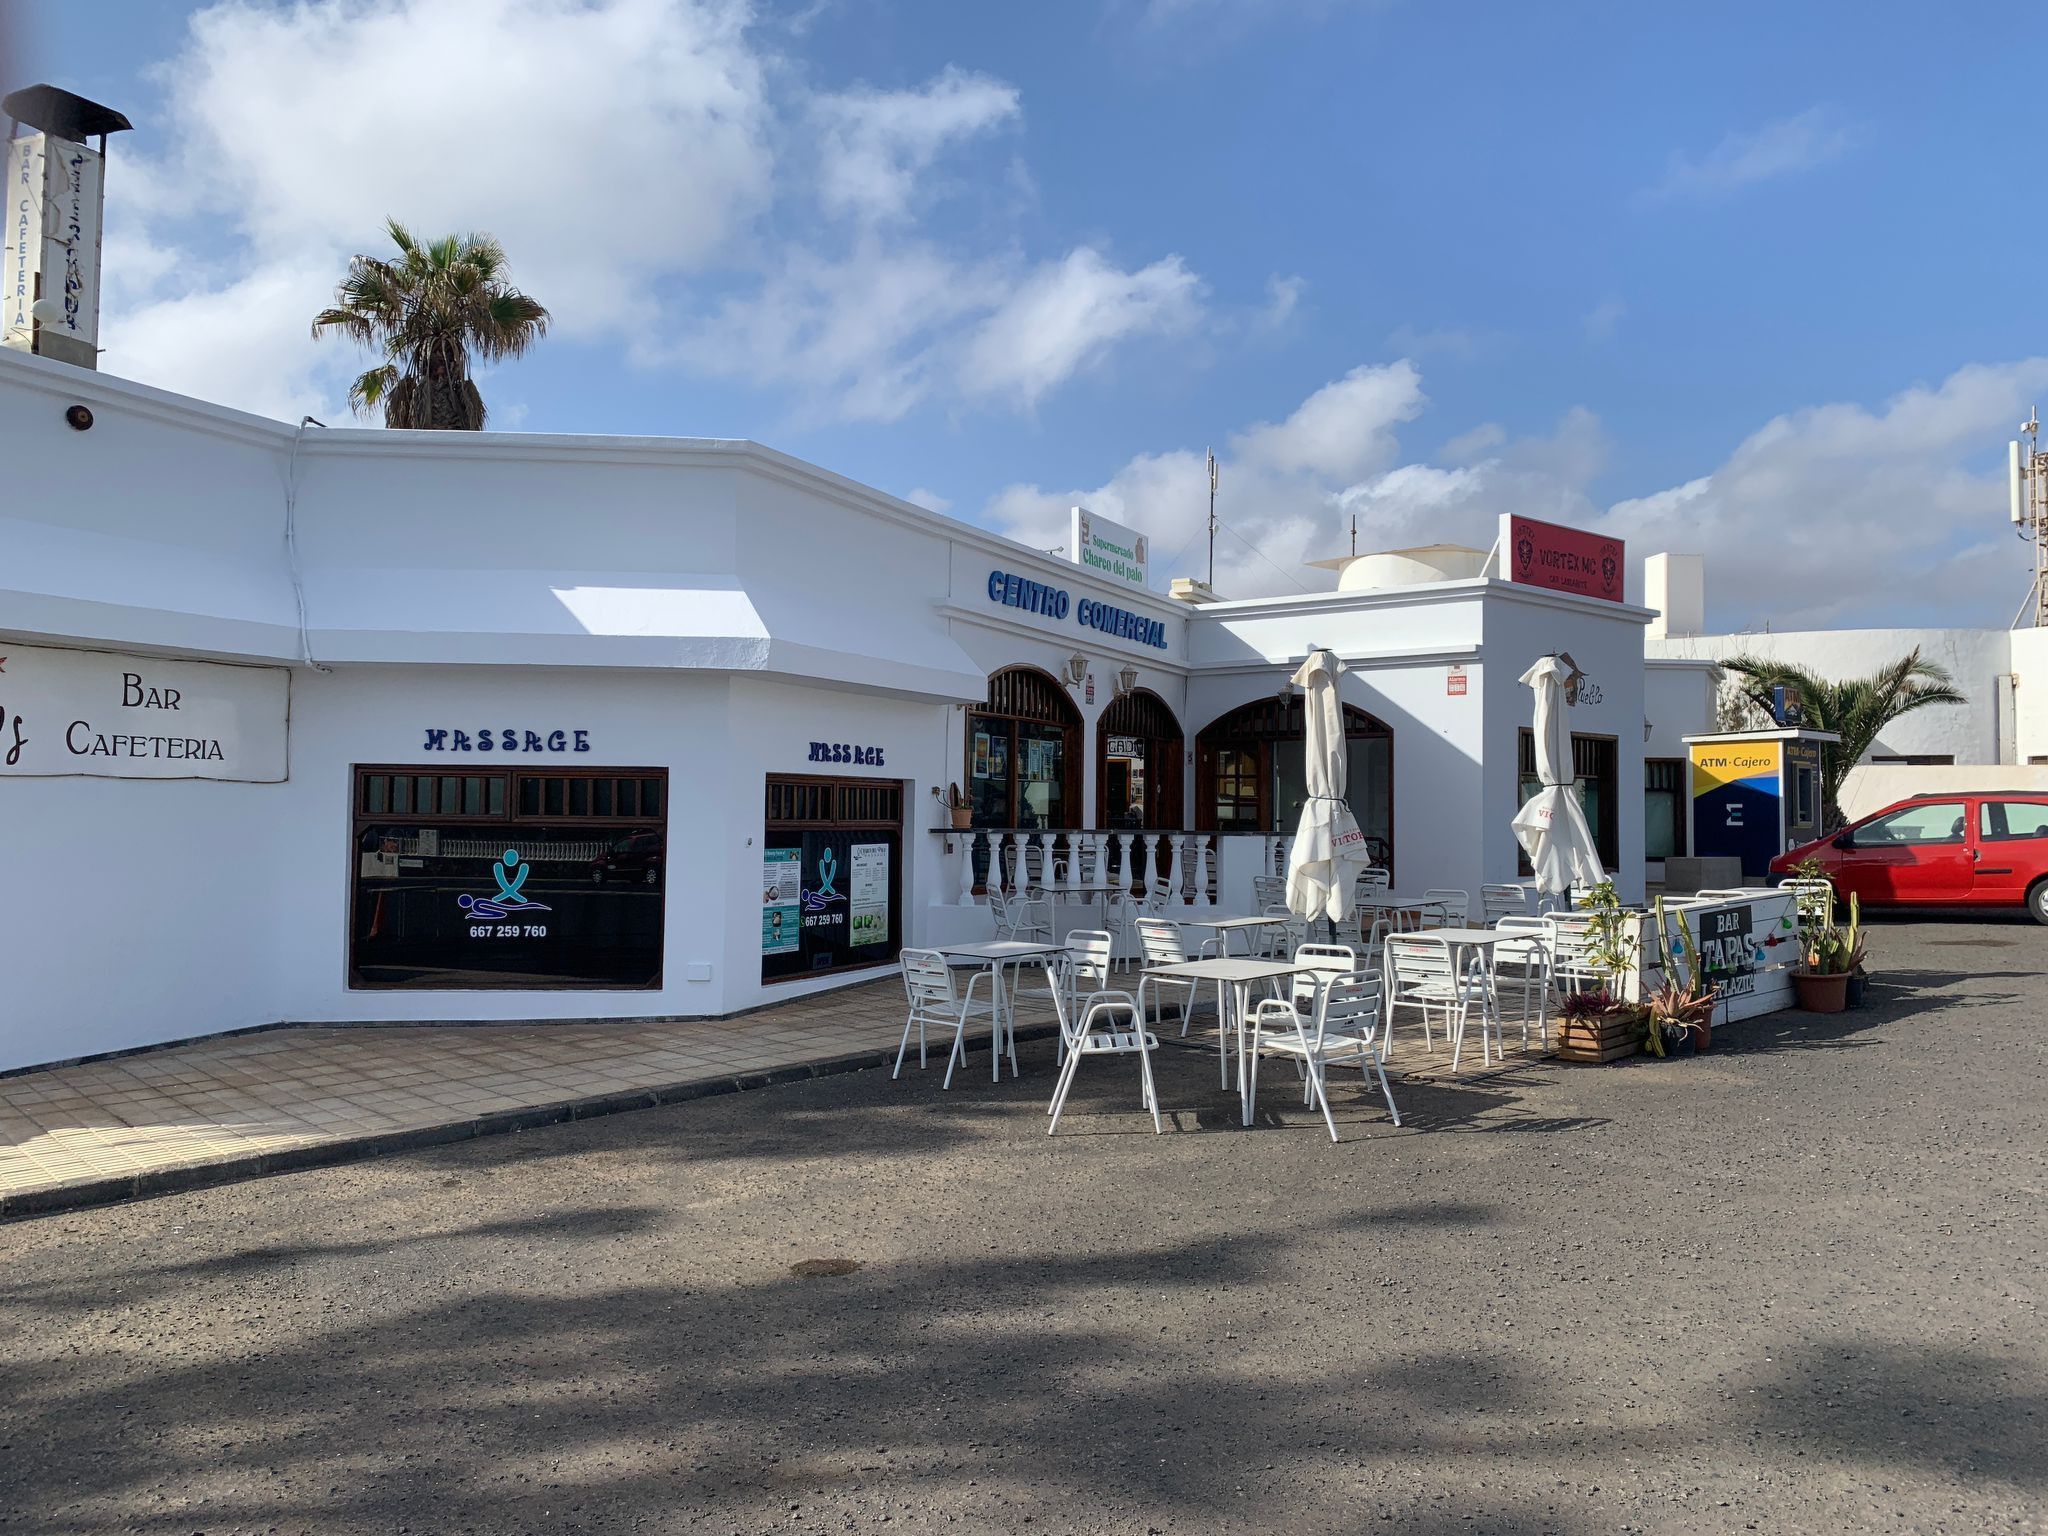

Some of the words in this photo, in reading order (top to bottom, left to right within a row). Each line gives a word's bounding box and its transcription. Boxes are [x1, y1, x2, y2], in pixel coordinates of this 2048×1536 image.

[21, 145, 31, 185] BAR
[15, 199, 28, 326] CAFETERIA
[1092, 534, 1134, 561] Supermercado
[1083, 547, 1112, 573] Charco
[1113, 559, 1125, 577] del
[1126, 564, 1143, 583] palo
[1539, 548, 1579, 571] VORTEX
[1581, 556, 1597, 575] MC
[988, 570, 1070, 620] CENTRO
[1078, 598, 1168, 650] COMERCIAL
[65, 720, 225, 761] CAFETERIA
[423, 728, 591, 752] MASSAGE
[808, 741, 885, 767] MASSAGE
[1700, 758, 1727, 767] ATM
[1733, 756, 1771, 769] Cajero
[470, 925, 493, 938] 667
[496, 925, 520, 938] 259
[523, 925, 547, 938] 760
[805, 914, 817, 927] 667
[818, 913, 831, 926] 259
[831, 912, 843, 925] 760
[1716, 912, 1740, 933] BAR
[1702, 932, 1756, 973] TAPAS
